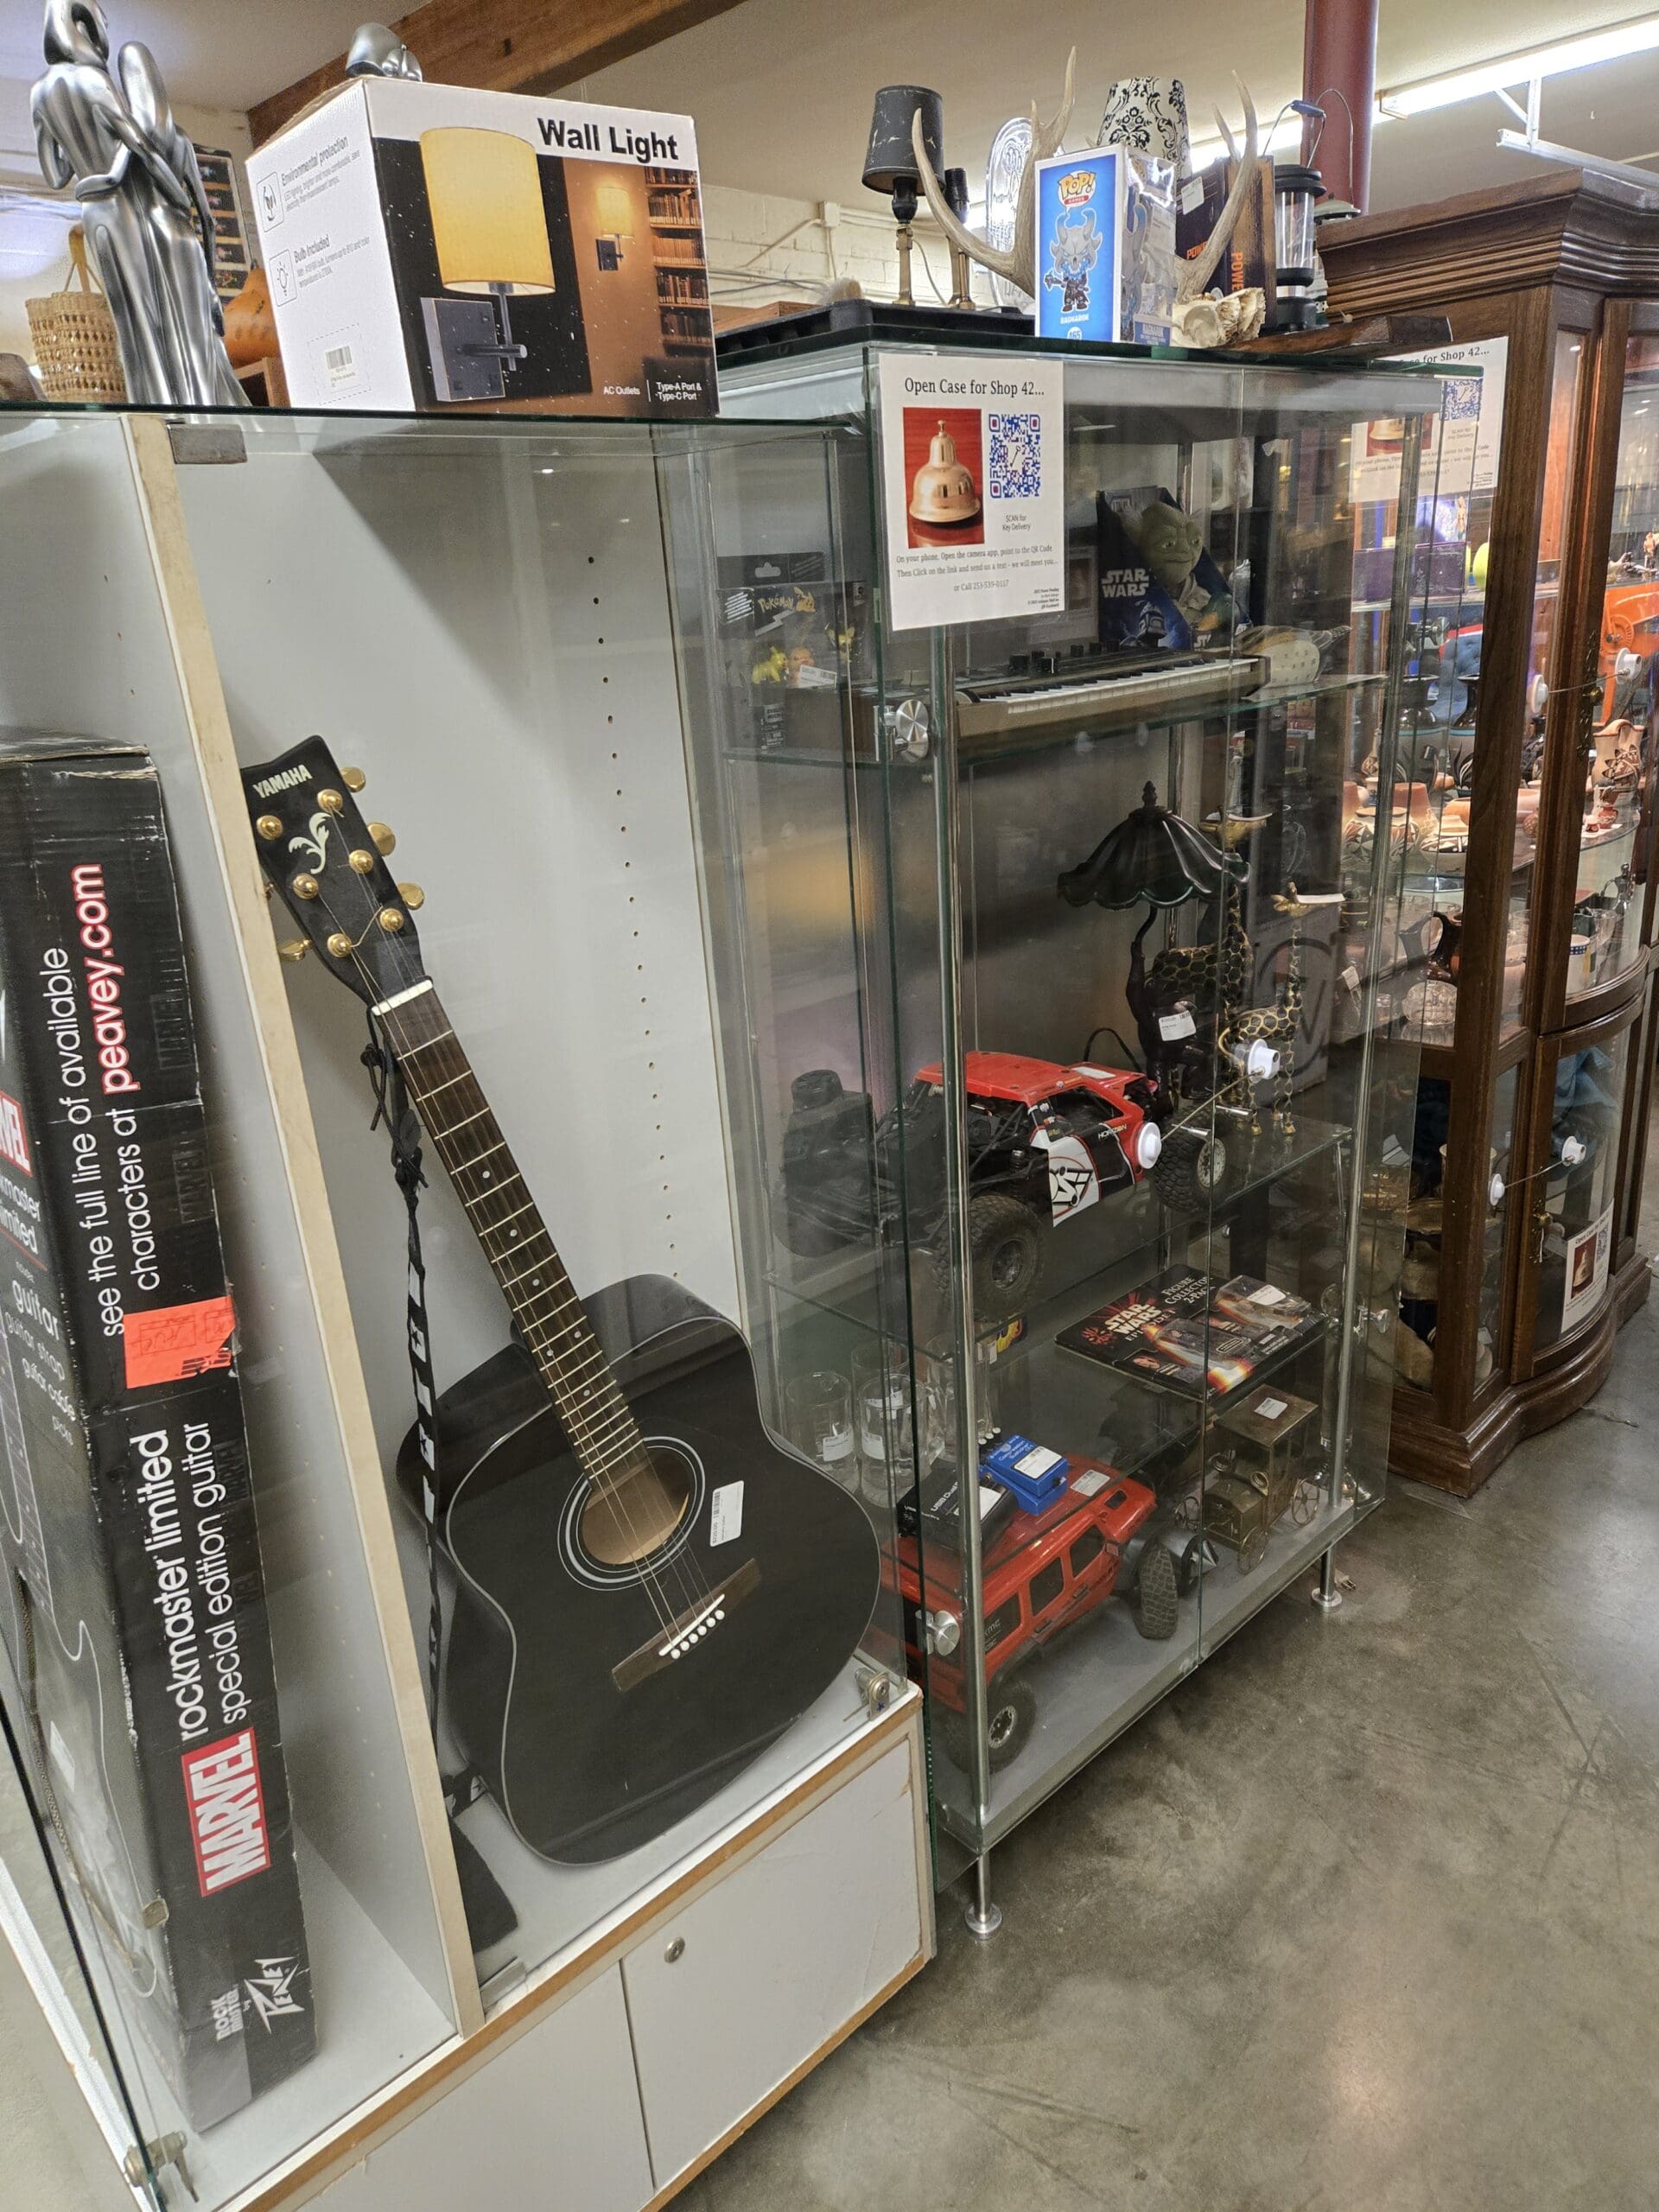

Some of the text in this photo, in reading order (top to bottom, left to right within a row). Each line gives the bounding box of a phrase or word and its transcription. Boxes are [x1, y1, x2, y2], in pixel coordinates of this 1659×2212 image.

[537, 118, 679, 163] Wall Light
[281, 151, 319, 187] Environmental
[319, 137, 349, 167] protection
[1058, 172, 1096, 200] POP!
[1440, 351, 1465, 361] Shop
[603, 386, 640, 395] AC Outlets
[657, 382, 681, 392] Type-A
[683, 392, 696, 401] Port
[905, 377, 1044, 398] Open Case for Shop 42...
[940, 552, 956, 561] Open
[1021, 545, 1030, 554] the
[1039, 544, 1052, 553] Code
[913, 568, 927, 576] Click
[937, 566, 946, 575] the
[961, 582, 972, 591] Call
[1101, 568, 1149, 585] STAR
[1102, 583, 1149, 598] WARS
[252, 764, 313, 798] YAMAHA
[70, 864, 160, 1290] characters at peavey.com
[40, 948, 125, 1336] see the full line of available
[1161, 1276, 1194, 1296] FIGURE
[12, 1280, 60, 1340] guitar
[1105, 1303, 1151, 1332] STAR
[1113, 1306, 1162, 1335] WARS
[5, 1312, 66, 1381] guitar strap
[22, 1357, 48, 1392] guitar
[182, 1422, 226, 1508] guitar
[196, 1513, 232, 1615] edition
[130, 1429, 209, 1741] rockmaster limited
[204, 1618, 252, 1725] special
[189, 1732, 267, 1891] MARVEL
[211, 1996, 231, 2042] ROCK
